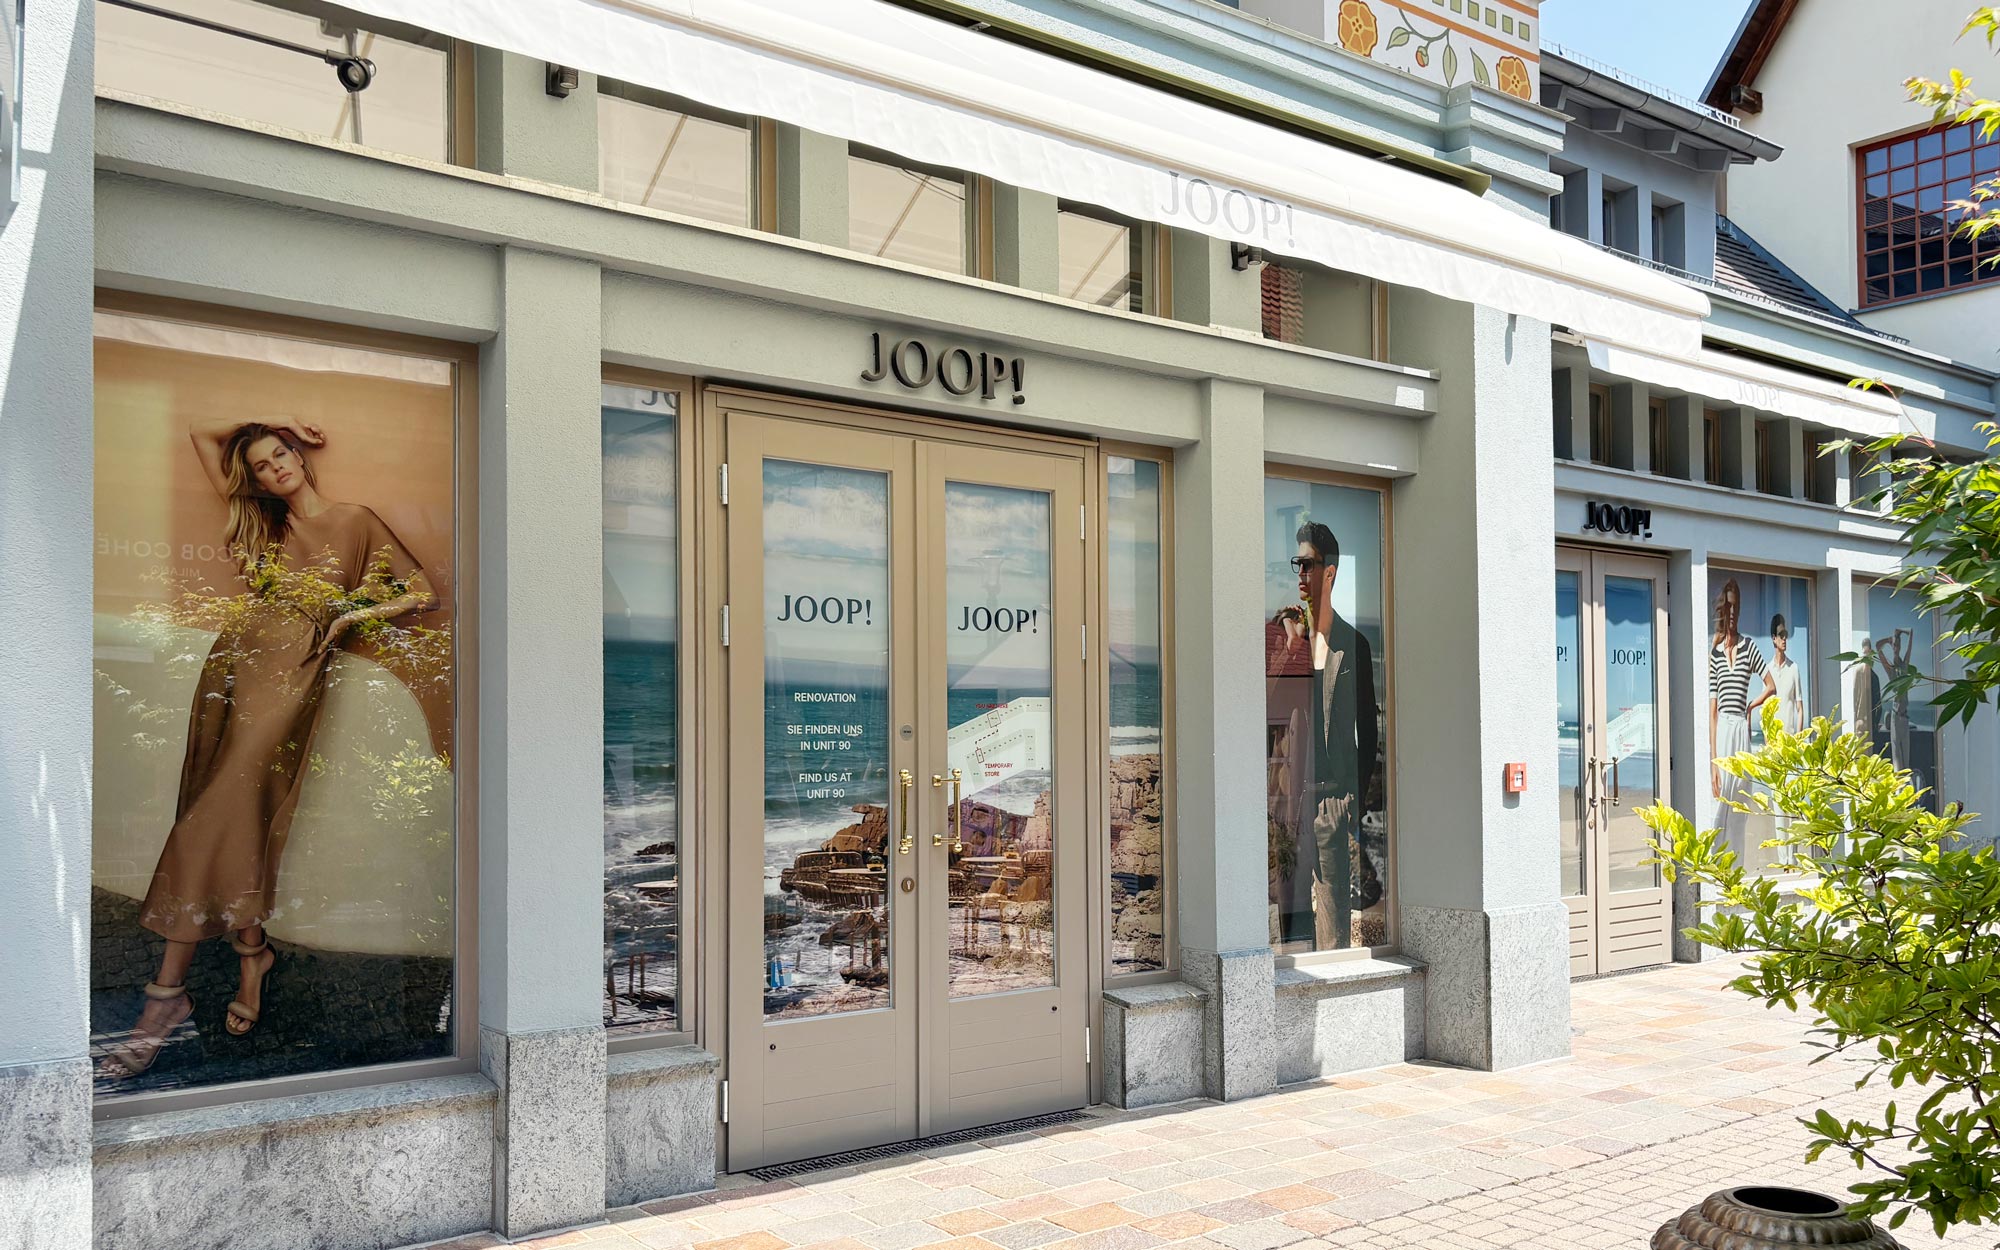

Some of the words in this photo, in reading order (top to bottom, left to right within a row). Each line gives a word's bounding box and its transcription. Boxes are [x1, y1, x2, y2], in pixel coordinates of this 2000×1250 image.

[1161, 170, 1295, 248] JOOP!
[861, 332, 1026, 405] JOOP!
[1583, 501, 1652, 538] JOOP!
[777, 594, 871, 626] JOOP!
[957, 606, 1037, 634] JOOP!
[1611, 649, 1646, 666] JOOP!
[794, 692, 856, 703] RENOVATION
[787, 725, 803, 735] SIE
[805, 725, 841, 735] FINDEN
[843, 725, 863, 735] UNS
[800, 741, 811, 751] IN
[813, 741, 836, 750] UNIT
[838, 741, 851, 750] 90
[799, 773, 822, 783] FIND
[824, 773, 837, 782] US
[839, 772, 852, 782] AT
[807, 789, 830, 799] UNIT
[832, 788, 845, 798] 90
